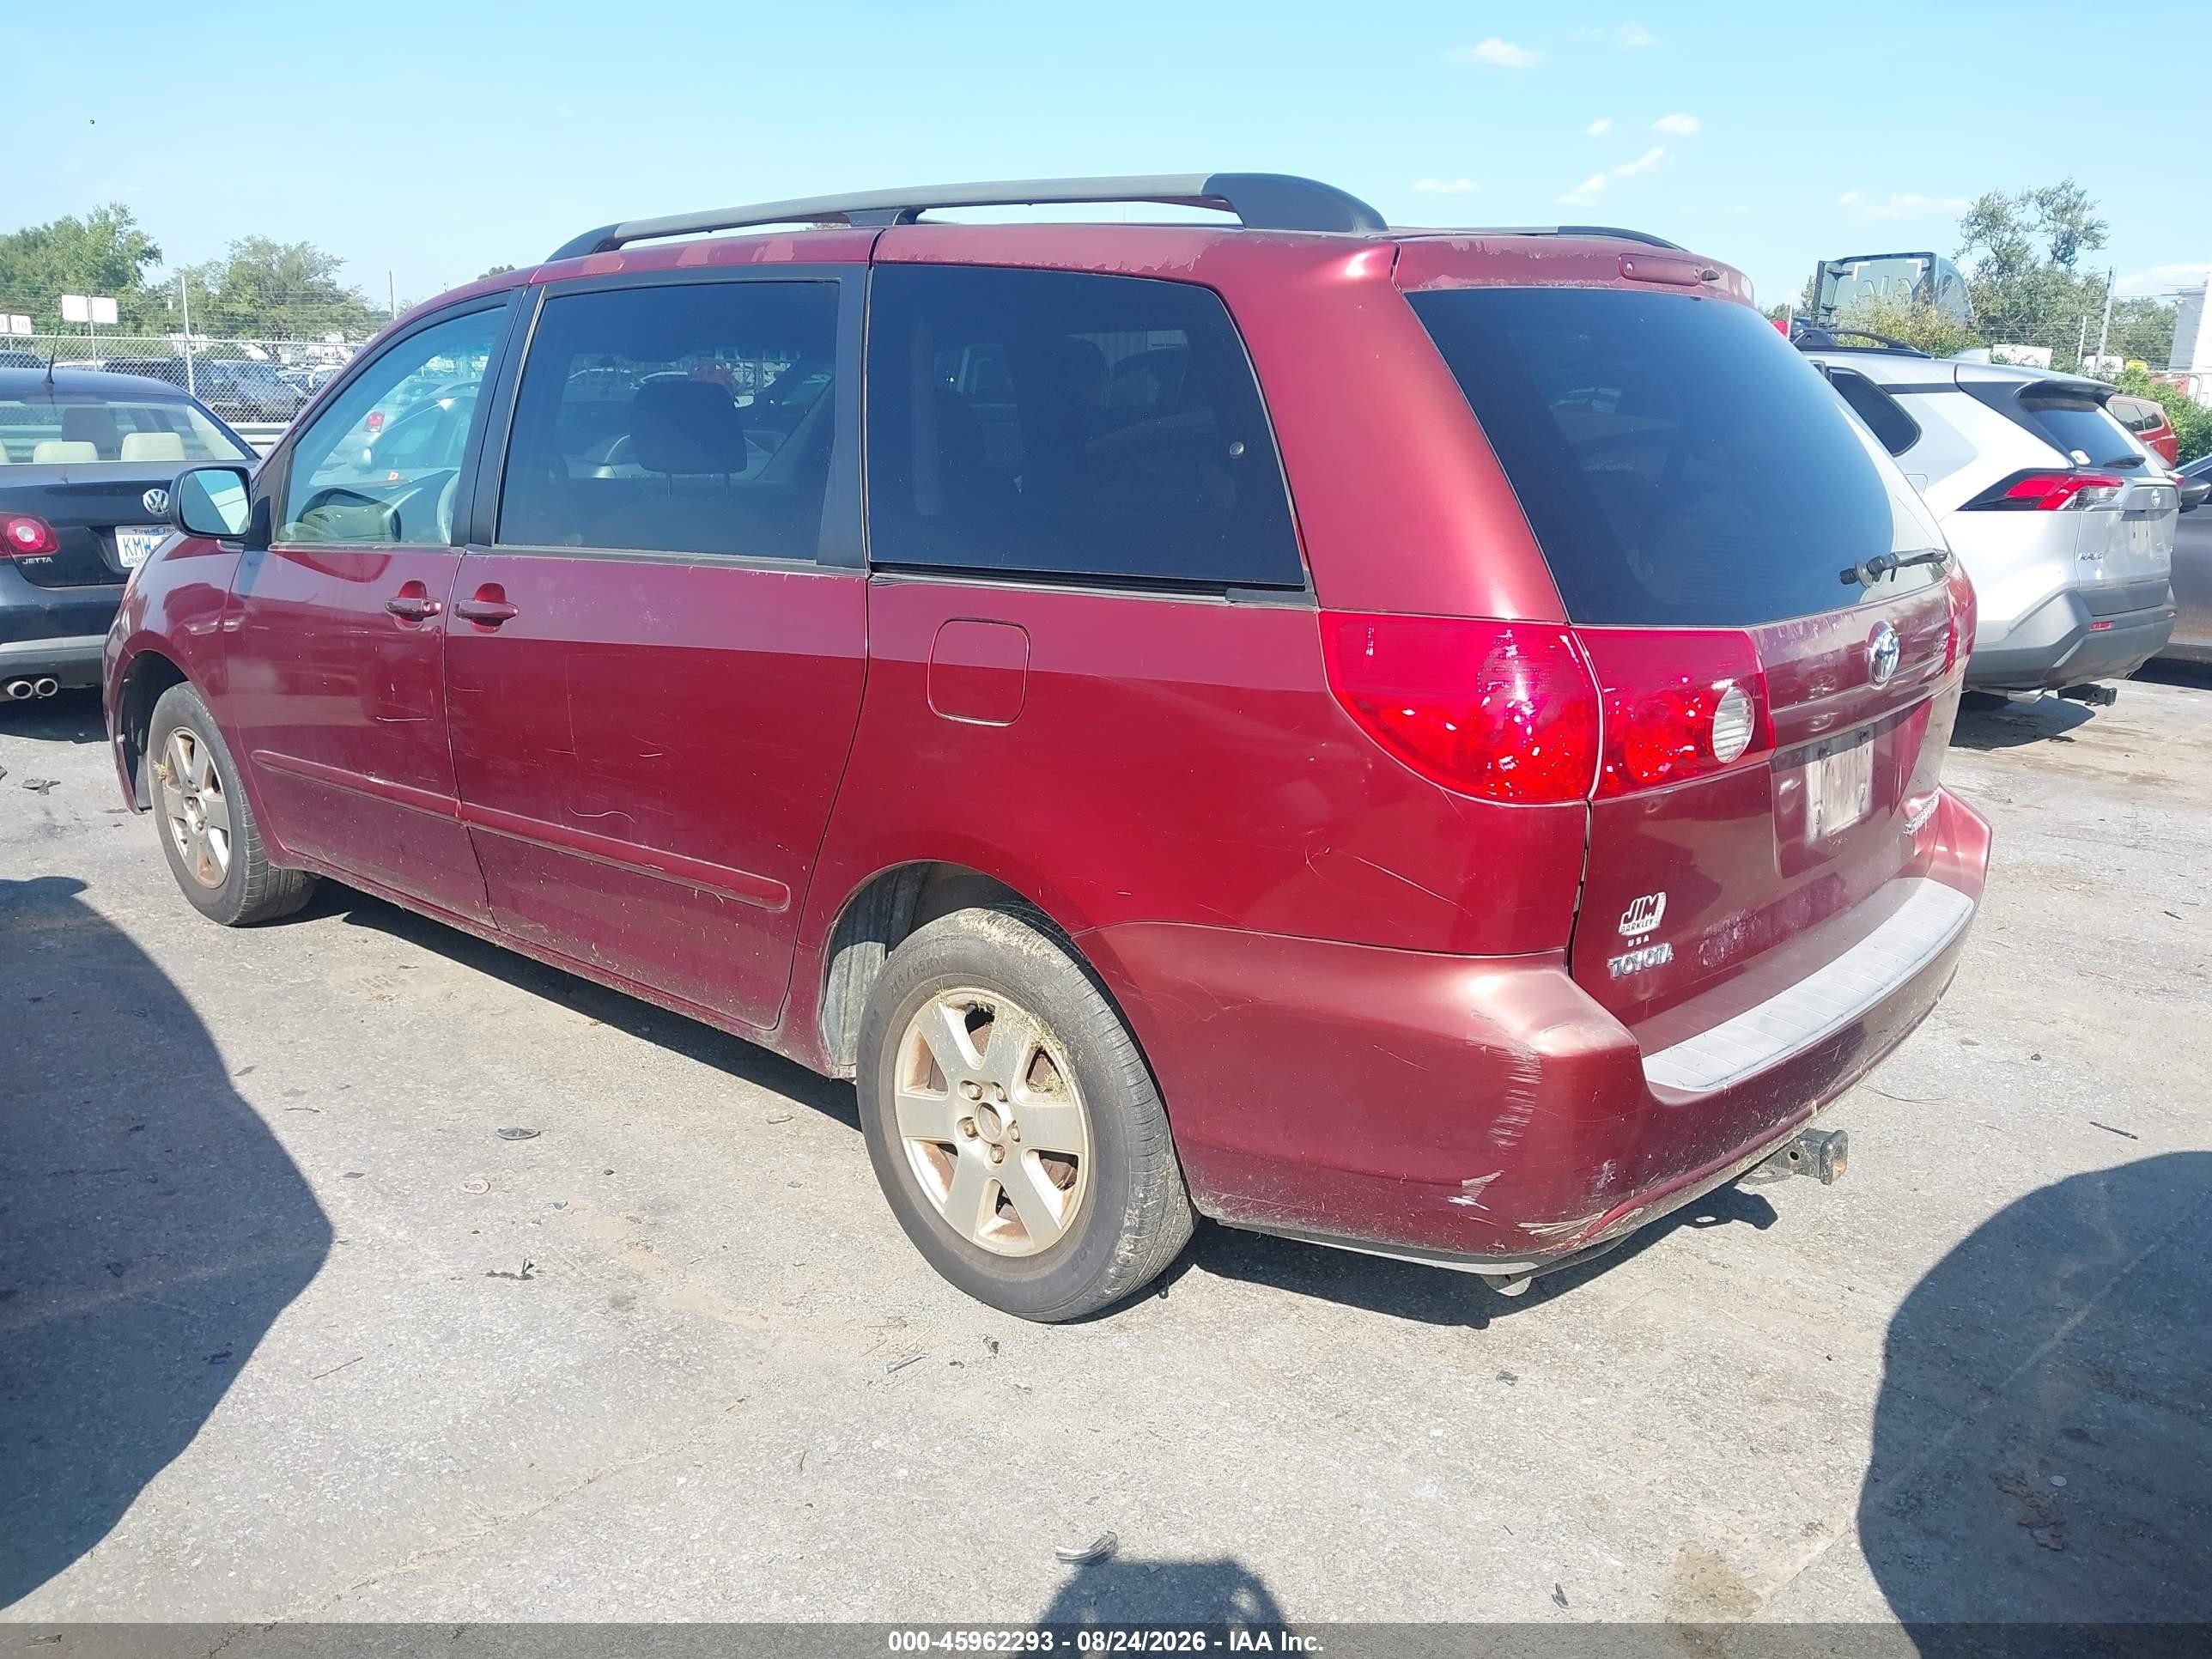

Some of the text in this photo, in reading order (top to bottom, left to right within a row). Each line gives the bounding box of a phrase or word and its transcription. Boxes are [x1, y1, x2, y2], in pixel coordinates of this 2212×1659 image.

[21, 556, 53, 565] JETTA
[1621, 892, 1660, 925] JIM
[1620, 919, 1654, 934] BARKLEY
[1627, 934, 1650, 947] USA
[1607, 942, 1674, 979] TOYOTA
